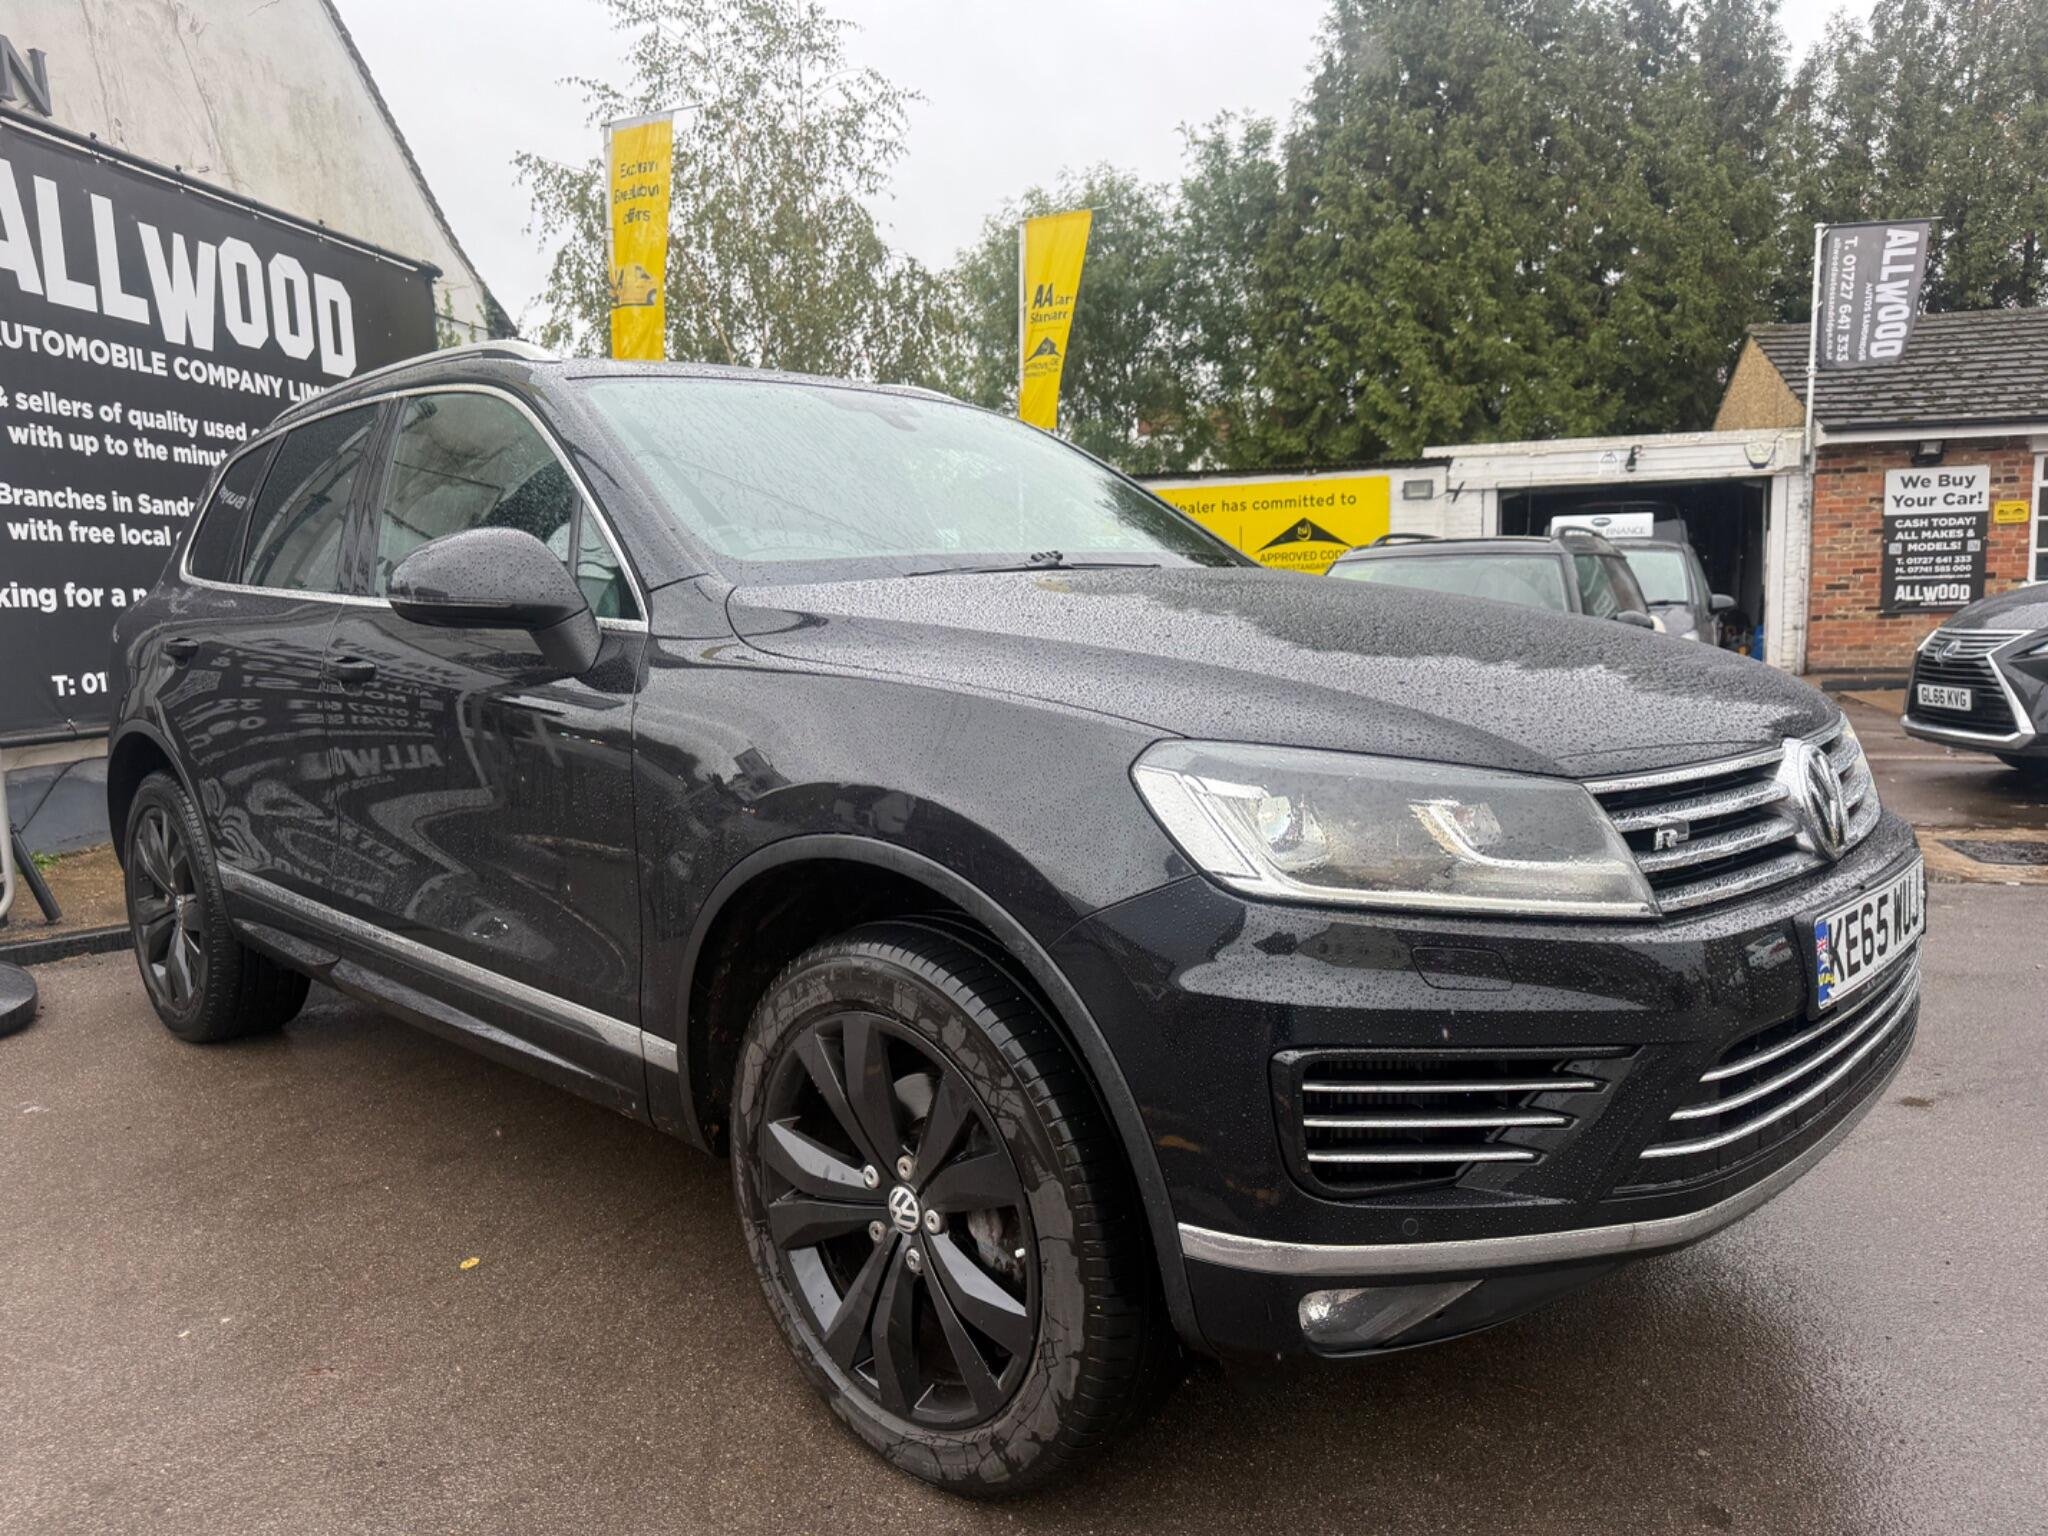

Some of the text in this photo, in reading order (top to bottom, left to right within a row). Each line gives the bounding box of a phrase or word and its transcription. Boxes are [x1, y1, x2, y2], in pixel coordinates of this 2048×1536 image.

[1844, 236, 1858, 250] T.
[0, 157, 357, 378] ALLWOOD
[1840, 254, 1857, 300] 01727
[1032, 283, 1053, 309] AA
[1870, 228, 1920, 358] ALLWOOD
[1837, 304, 1852, 330] 641
[0, 320, 327, 401] UTOMOBILE COMPANY LIM
[15, 391, 94, 420] sellers
[99, 402, 122, 423] of
[128, 408, 198, 438] quality
[203, 421, 247, 441] used
[7, 423, 63, 449] with
[69, 433, 99, 456] up
[105, 434, 128, 456] to
[133, 437, 168, 461] the
[1900, 474, 1976, 489] We Buy
[0, 482, 107, 512] Branches
[112, 490, 133, 513] in
[1175, 493, 1357, 515] ealer has committed to
[1892, 491, 1983, 508] Your Car!
[7, 518, 63, 542] with
[68, 520, 115, 544] free
[120, 523, 171, 546] local
[1895, 516, 1976, 528] CASH TODAY!
[1895, 530, 1918, 540] ALL
[1921, 529, 1964, 539] MAKES
[1260, 548, 1346, 562] APPROVED COD
[1907, 541, 1961, 552] MODELS!
[64, 582, 104, 608] for
[111, 588, 126, 607] a
[1894, 583, 1971, 601] ALLWOOD
[51, 675, 76, 697] T:
[1828, 867, 1919, 983] KE65 WUJ
